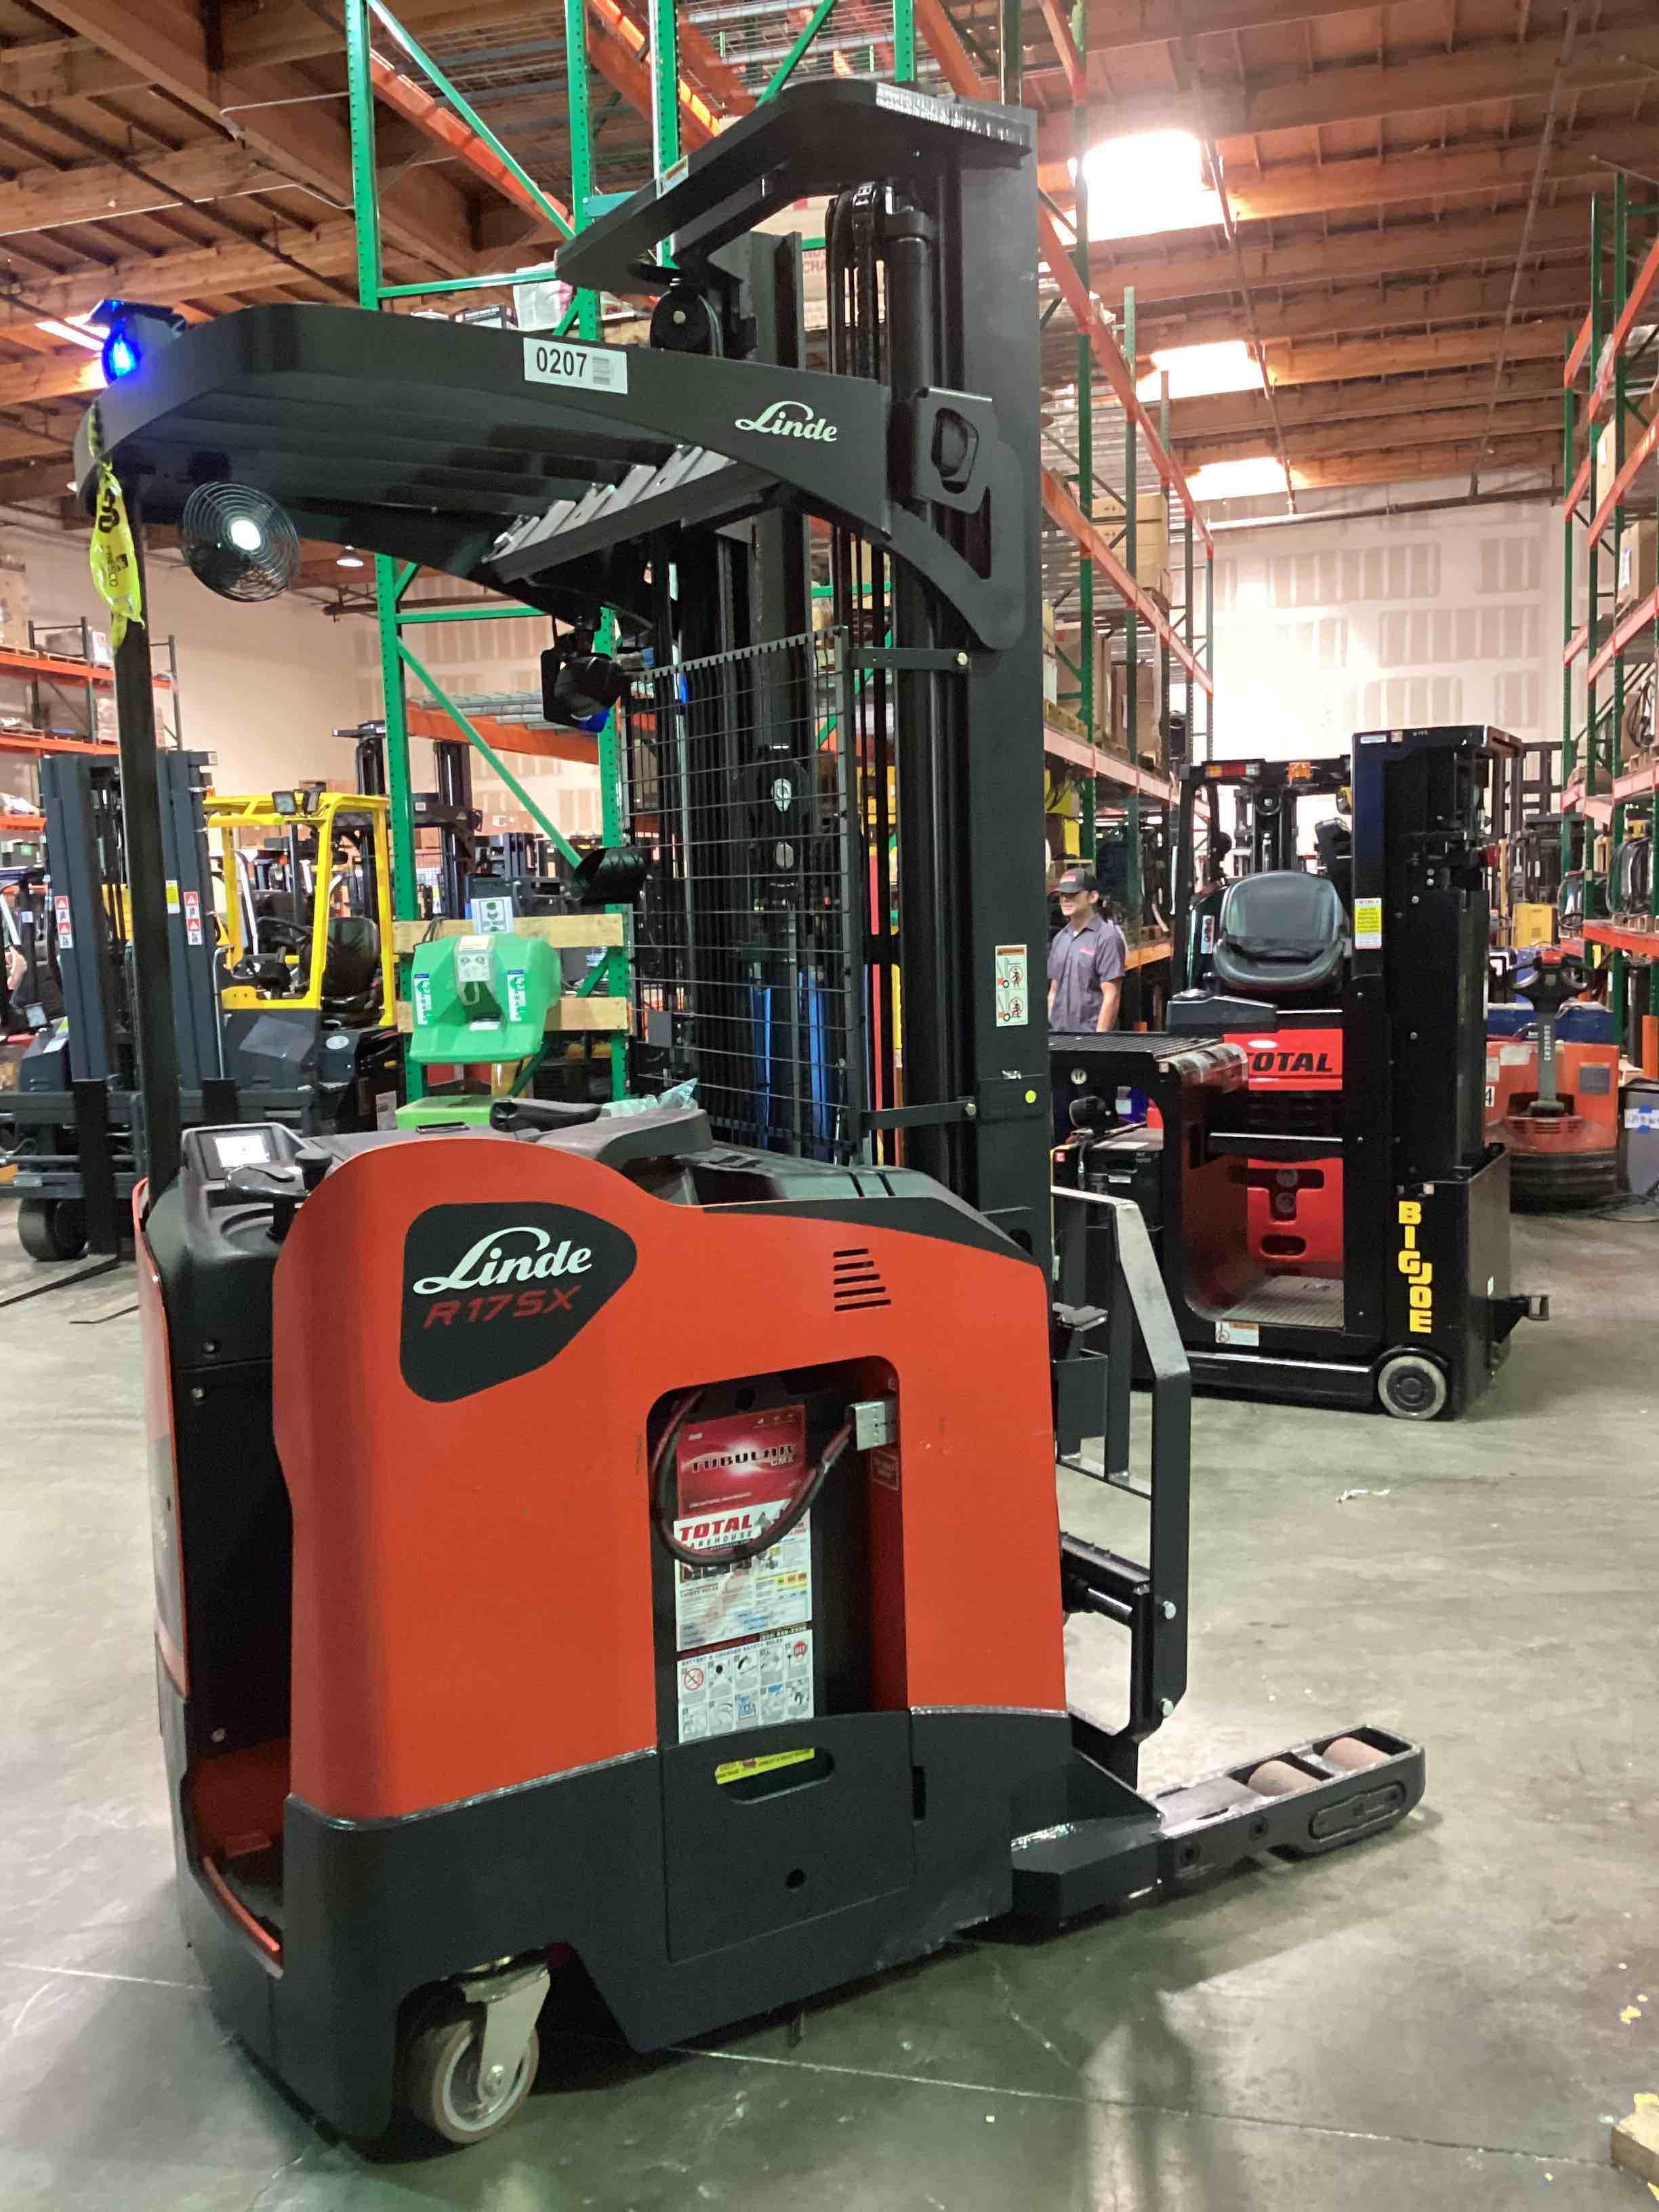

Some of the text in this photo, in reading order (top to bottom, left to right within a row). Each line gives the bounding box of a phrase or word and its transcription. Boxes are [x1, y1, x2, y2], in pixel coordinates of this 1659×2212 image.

[536, 347, 588, 377] 0207
[735, 401, 838, 442] Linde
[1398, 1201, 1422, 1274] BIG
[413, 1227, 592, 1295] Linde
[1408, 1263, 1433, 1334] JOE
[692, 1443, 796, 1474] TUBULAR
[679, 1514, 753, 1541] TOTAL
